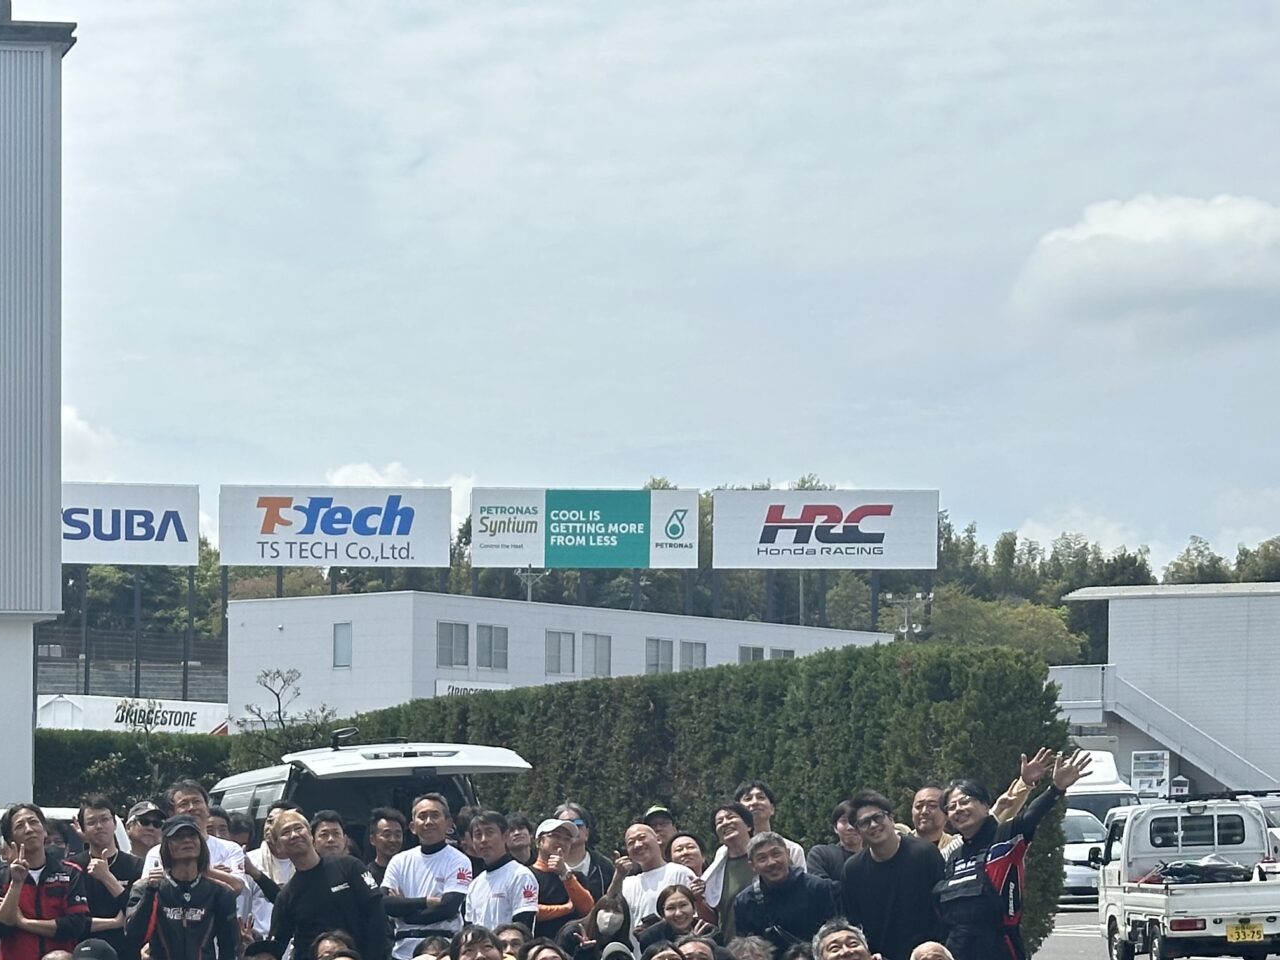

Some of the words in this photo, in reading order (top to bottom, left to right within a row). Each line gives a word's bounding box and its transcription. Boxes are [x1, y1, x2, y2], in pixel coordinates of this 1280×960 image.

[480, 506, 538, 515] PETRONAS
[550, 510, 586, 521] COOL
[589, 511, 600, 521] IS
[61, 507, 189, 542] SUBA
[478, 516, 538, 537] Syntium
[550, 523, 605, 533] GETTING
[608, 524, 644, 533] MORE
[759, 504, 894, 544] HRC
[550, 536, 586, 546] FROM
[590, 536, 618, 546] LESS
[256, 542, 280, 559] TS
[285, 542, 338, 559] TECH
[757, 546, 817, 556] Honda
[821, 546, 884, 556] RACING
[114, 705, 197, 727] BRIDGESTONE
